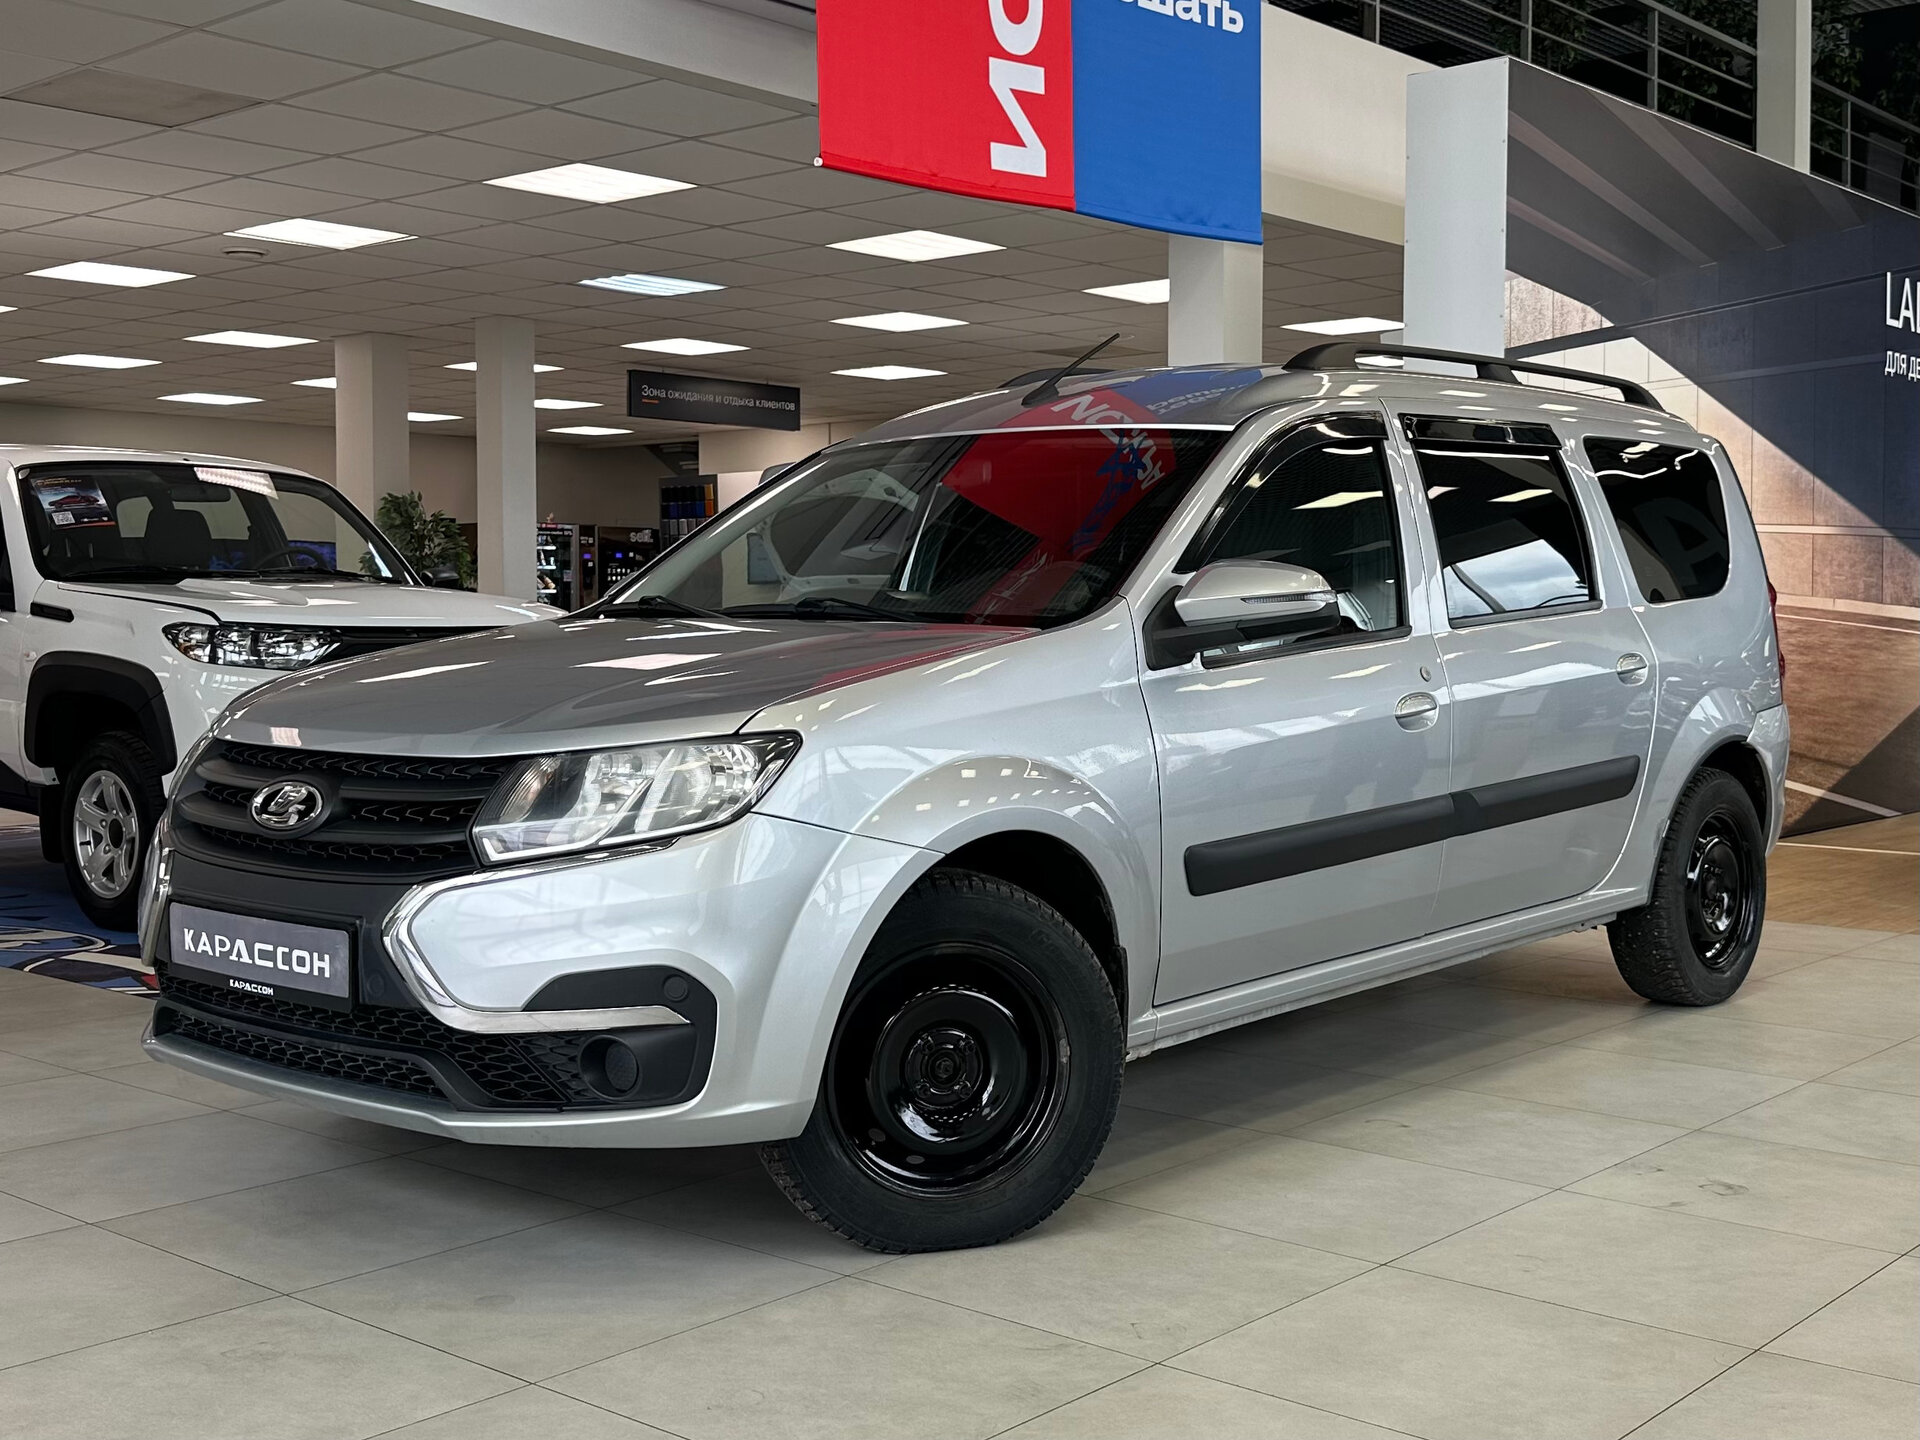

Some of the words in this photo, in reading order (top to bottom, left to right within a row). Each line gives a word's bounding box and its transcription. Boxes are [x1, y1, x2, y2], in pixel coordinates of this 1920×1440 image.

[641, 384, 666, 398] Зона
[668, 390, 714, 403] ожидания
[723, 396, 755, 407] отдыха
[755, 400, 796, 411] клиентов
[183, 927, 330, 978] КАРАССОН
[229, 978, 274, 996] КАРАССОН
